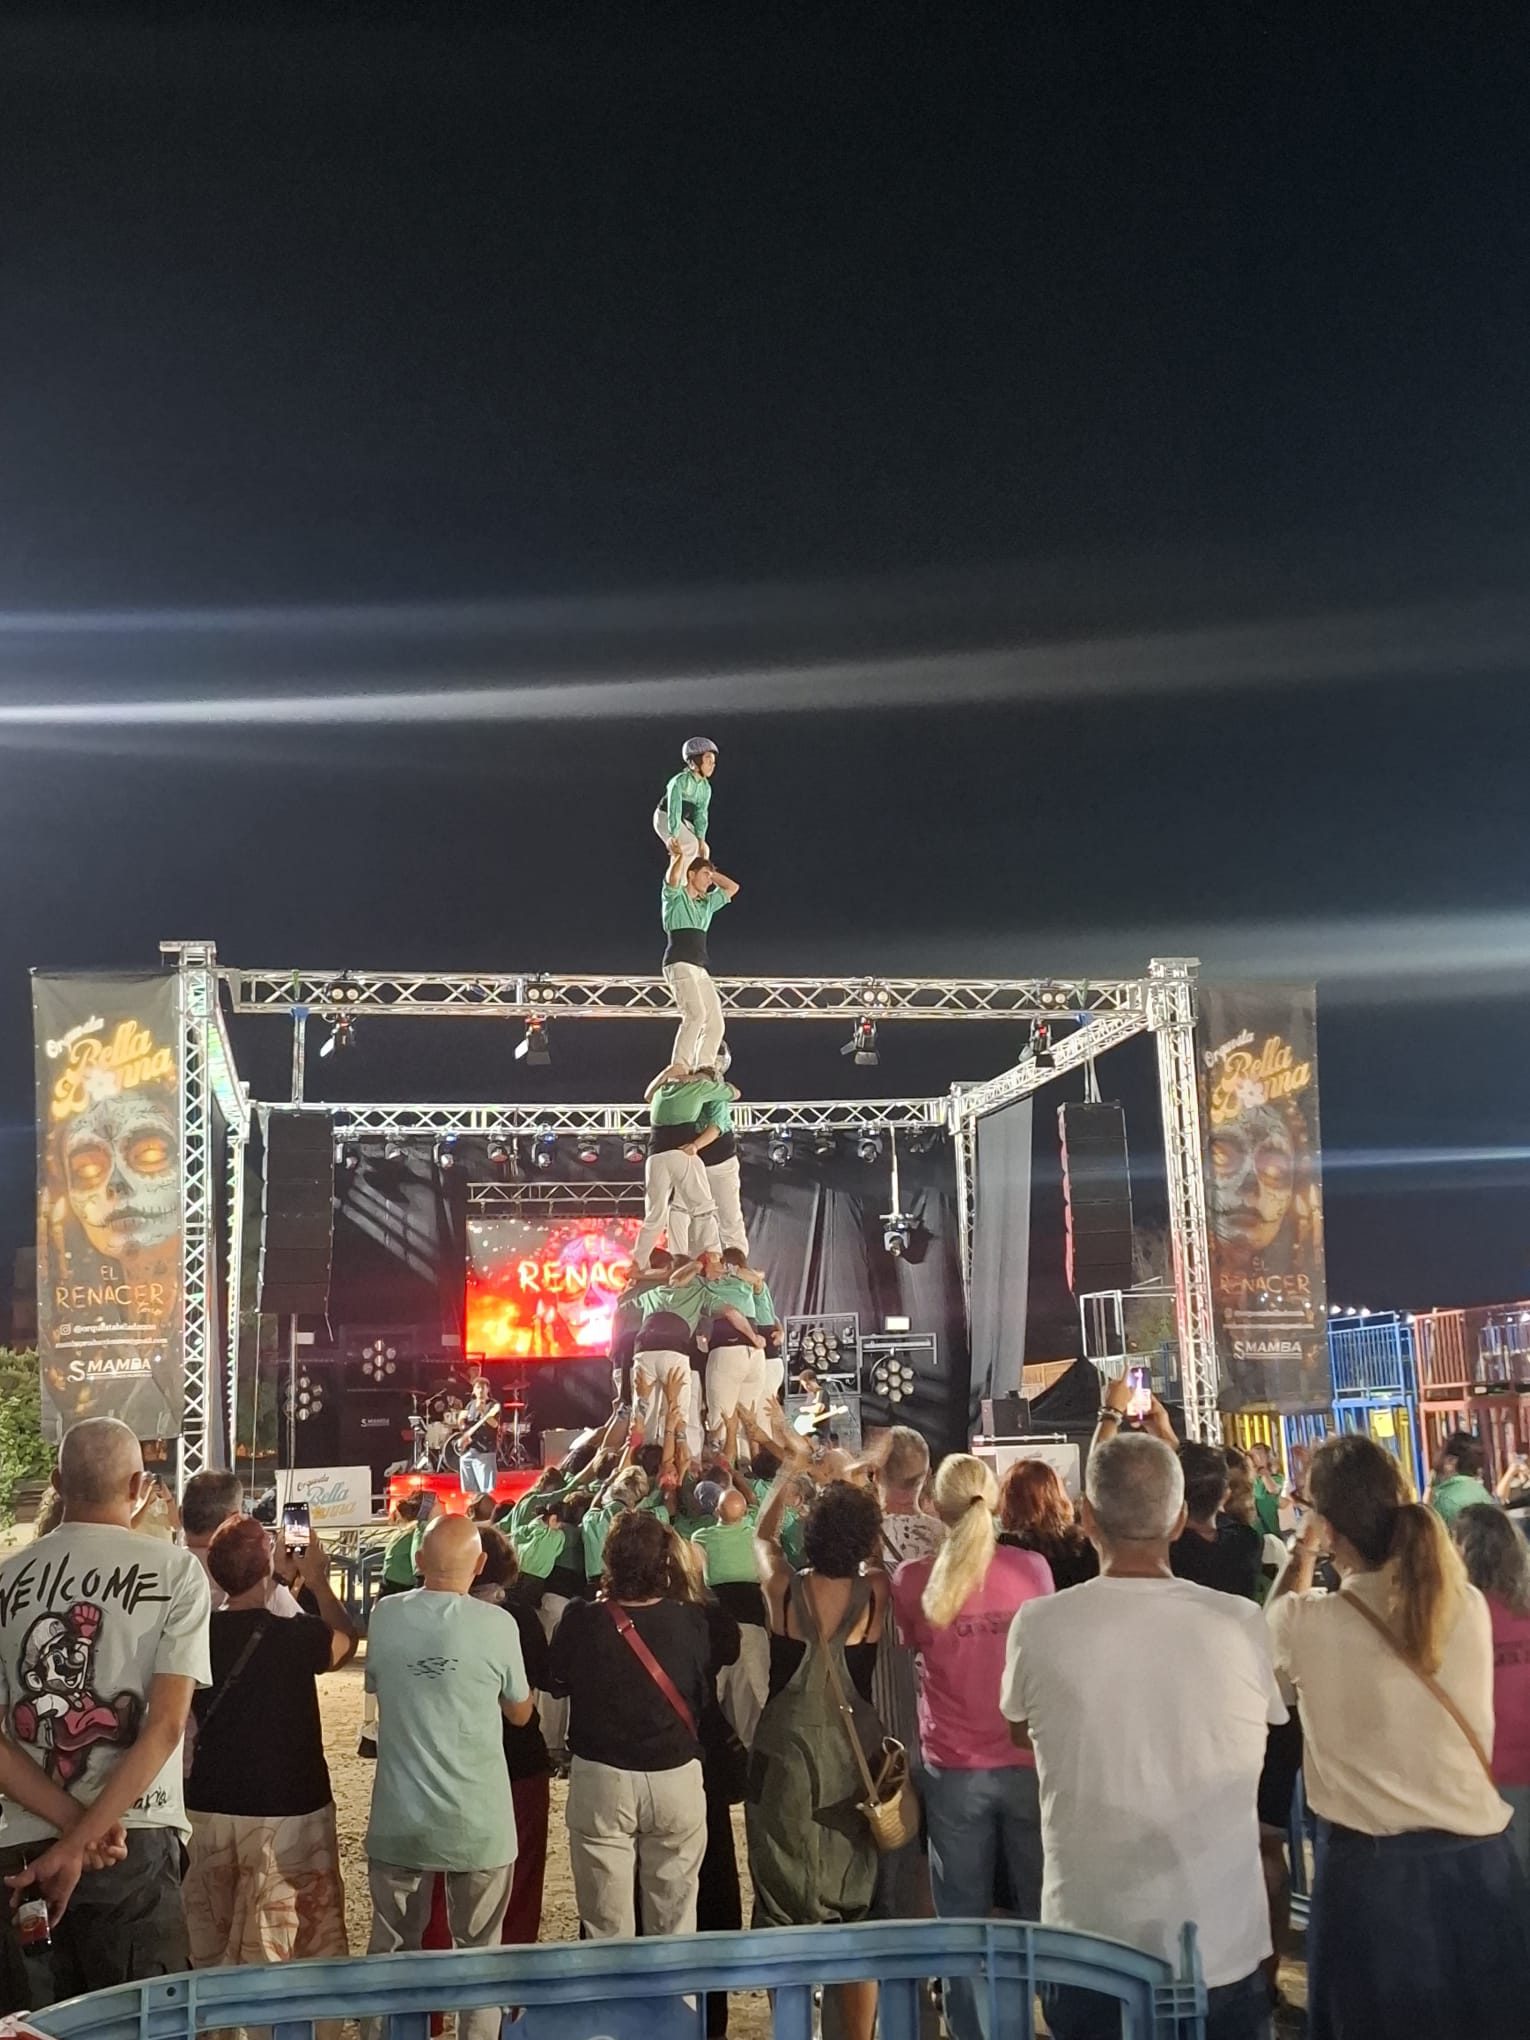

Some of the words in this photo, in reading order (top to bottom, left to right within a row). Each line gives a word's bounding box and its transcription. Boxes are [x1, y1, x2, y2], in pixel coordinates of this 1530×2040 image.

[69, 1020, 152, 1079] Bella
[1223, 1036, 1293, 1092] Bella
[584, 1234, 612, 1255] EL
[100, 1265, 118, 1281] EL
[517, 1260, 632, 1293] RENAC
[56, 1283, 164, 1309] RENACER
[306, 1481, 349, 1506] Bella
